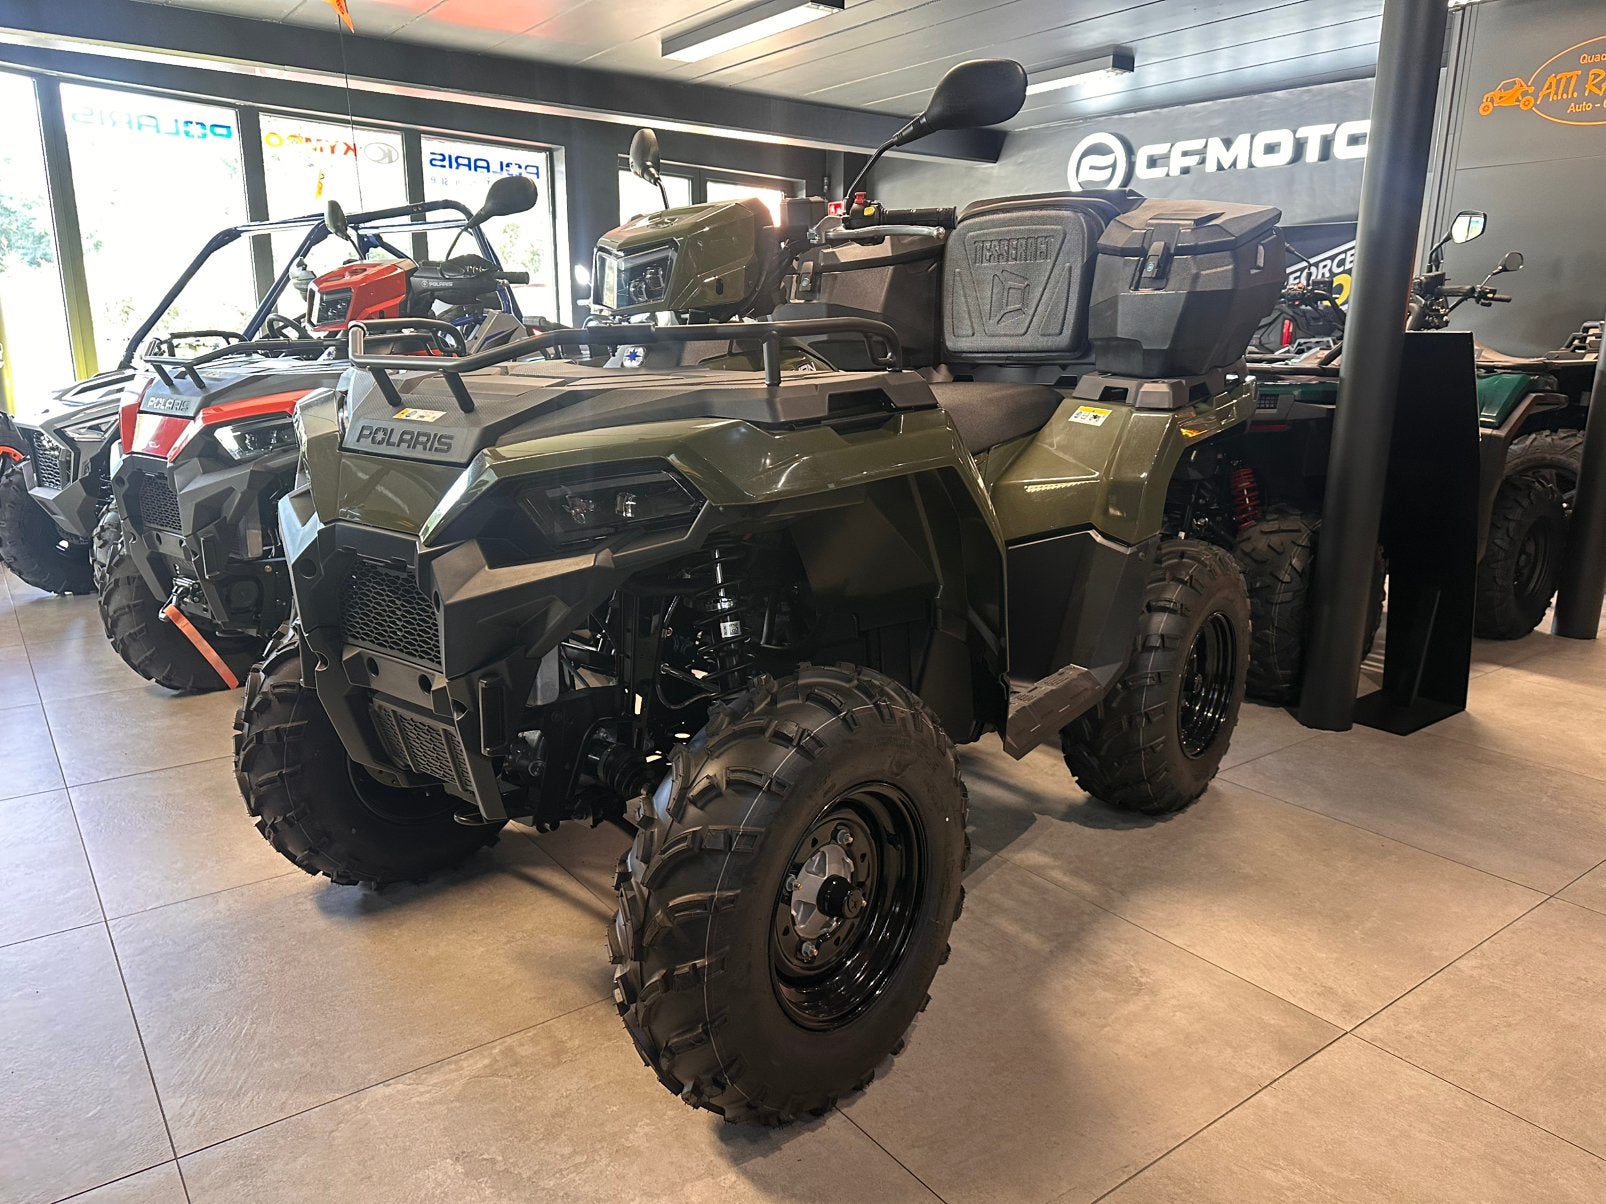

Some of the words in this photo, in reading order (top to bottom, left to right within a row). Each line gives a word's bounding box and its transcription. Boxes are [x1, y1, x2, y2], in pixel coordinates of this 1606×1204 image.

[1584, 68, 1606, 96] R
[1567, 101, 1593, 113] Auto
[1135, 119, 1371, 180] CFMOTO
[147, 396, 191, 411] POLARIS
[356, 424, 454, 454] POLARIS
